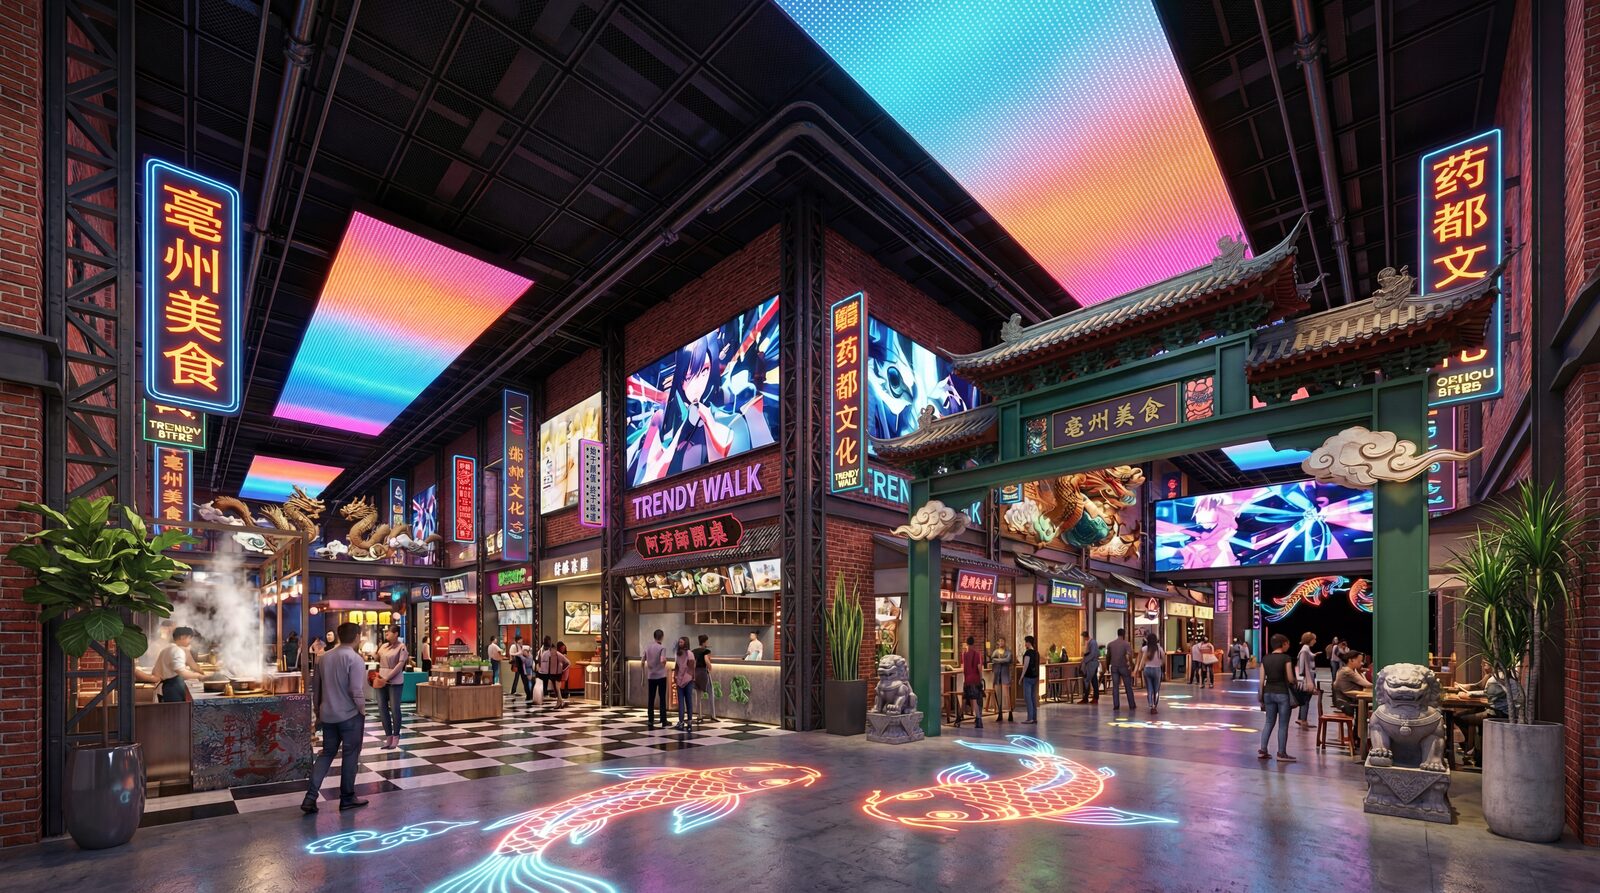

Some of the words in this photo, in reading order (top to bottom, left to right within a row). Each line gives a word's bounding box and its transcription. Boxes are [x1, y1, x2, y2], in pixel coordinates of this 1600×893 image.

[163, 184, 224, 391] 亳州美食
[1432, 146, 1489, 367] 药都文
[835, 336, 858, 467] 药都文化
[1064, 397, 1165, 438] 亳州美食
[632, 481, 698, 520] TRENDY
[702, 463, 762, 504] WALK
